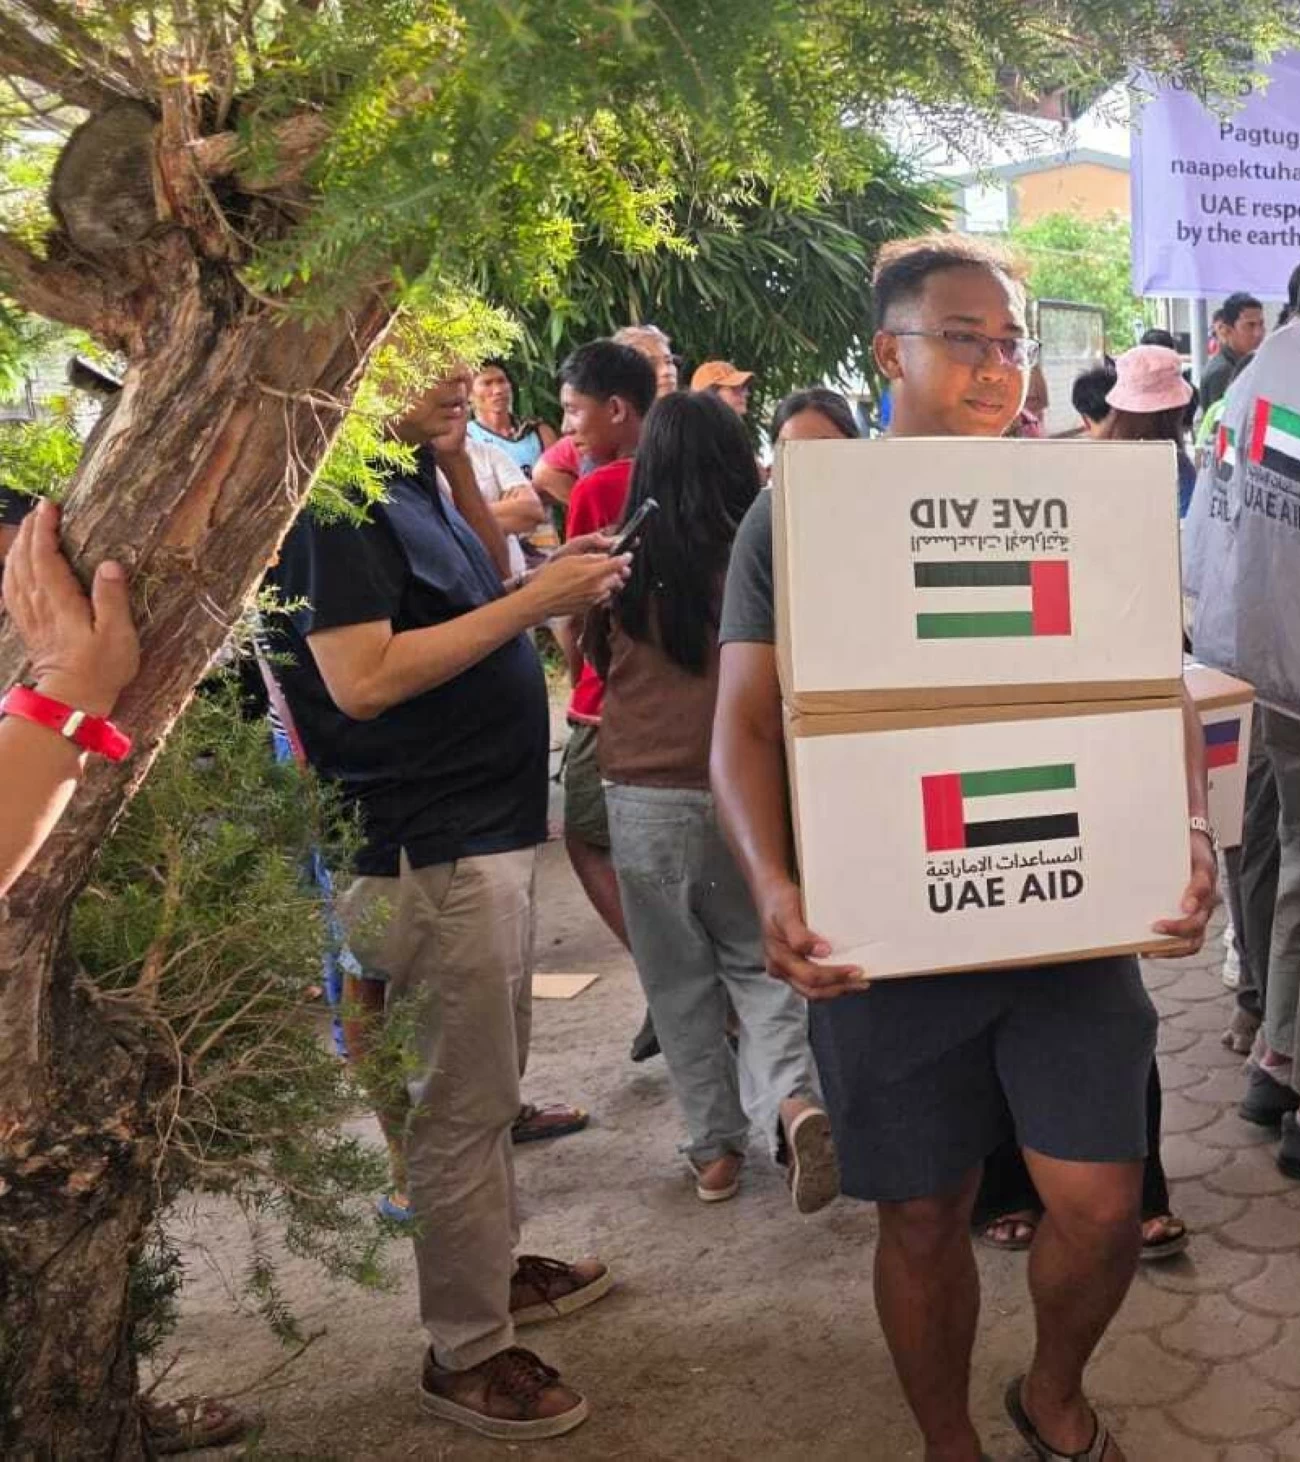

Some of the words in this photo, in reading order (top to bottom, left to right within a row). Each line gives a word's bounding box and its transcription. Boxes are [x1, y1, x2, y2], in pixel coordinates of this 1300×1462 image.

[1201, 194, 1246, 216] UAE
[1177, 220, 1202, 246] by
[1207, 222, 1241, 244] the
[910, 498, 980, 528] AID
[992, 498, 1068, 528] UAE
[1245, 481, 1276, 519] UAE
[911, 535, 1001, 552] المساعدات
[926, 856, 992, 881] الإماراتية
[996, 846, 1083, 871] المساعدات
[928, 876, 1005, 914] UAE
[1018, 869, 1084, 903] AID
